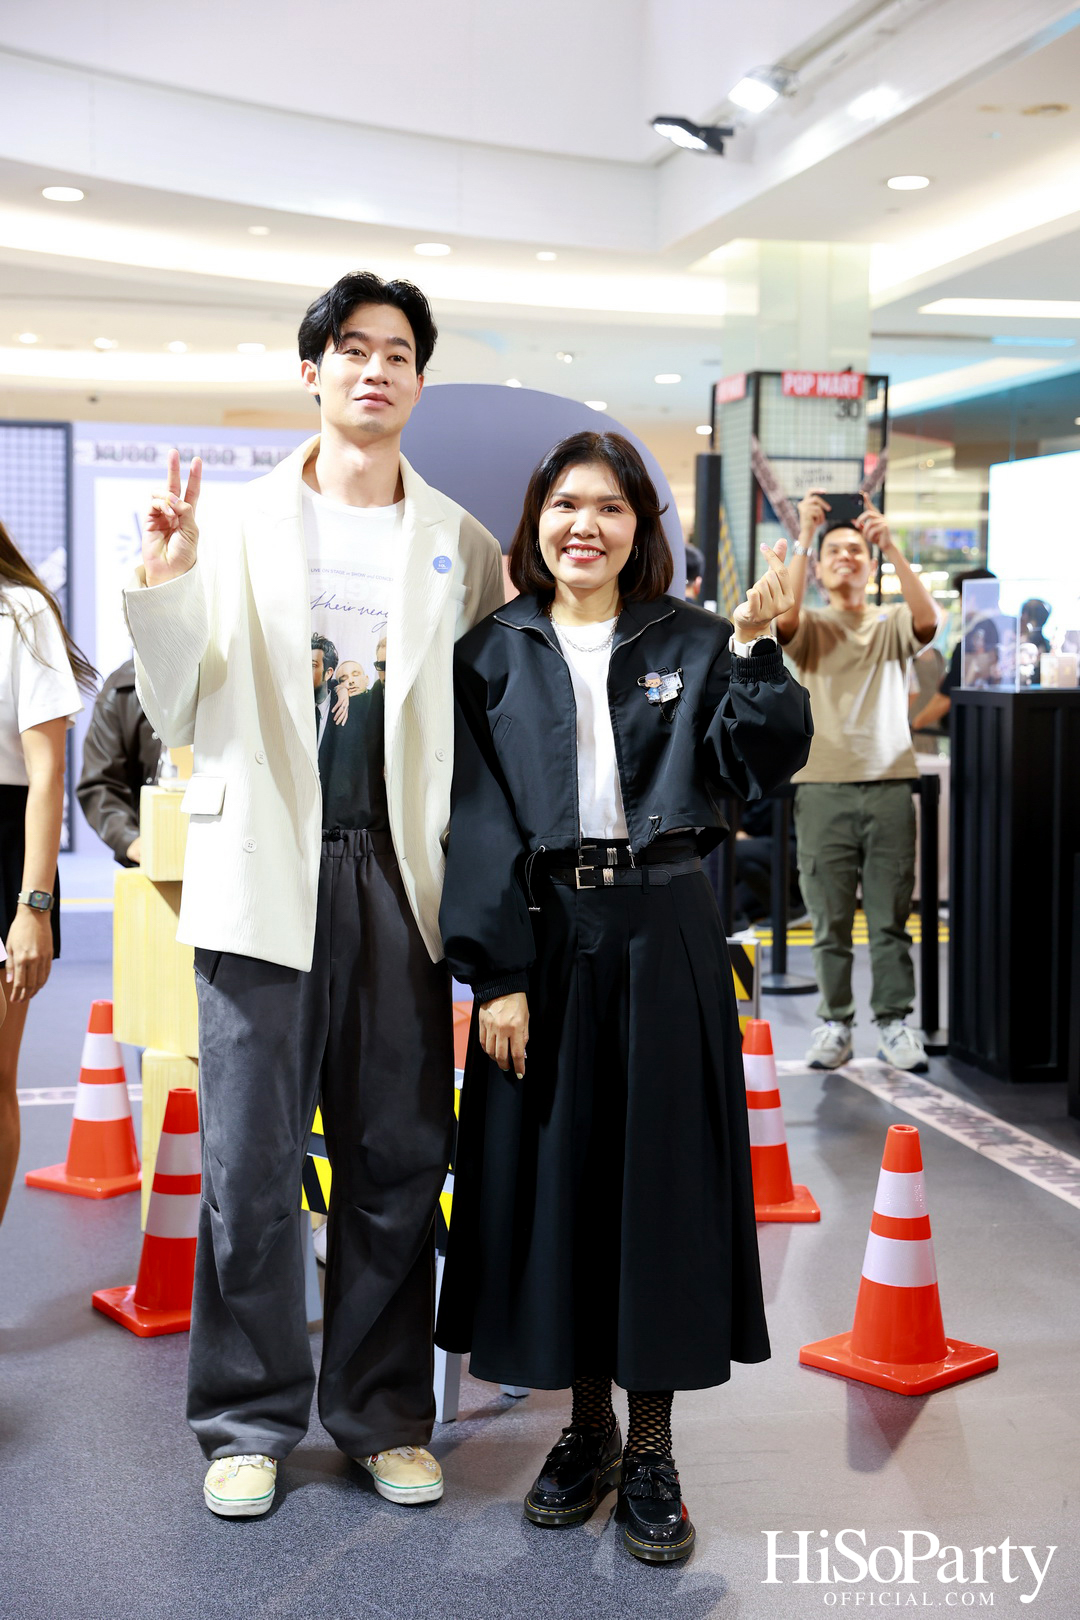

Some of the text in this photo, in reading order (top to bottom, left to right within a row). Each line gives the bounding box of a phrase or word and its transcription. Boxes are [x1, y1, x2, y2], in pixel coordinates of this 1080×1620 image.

[783, 372, 861, 397] POP MART
[330, 568, 346, 576] STAGE
